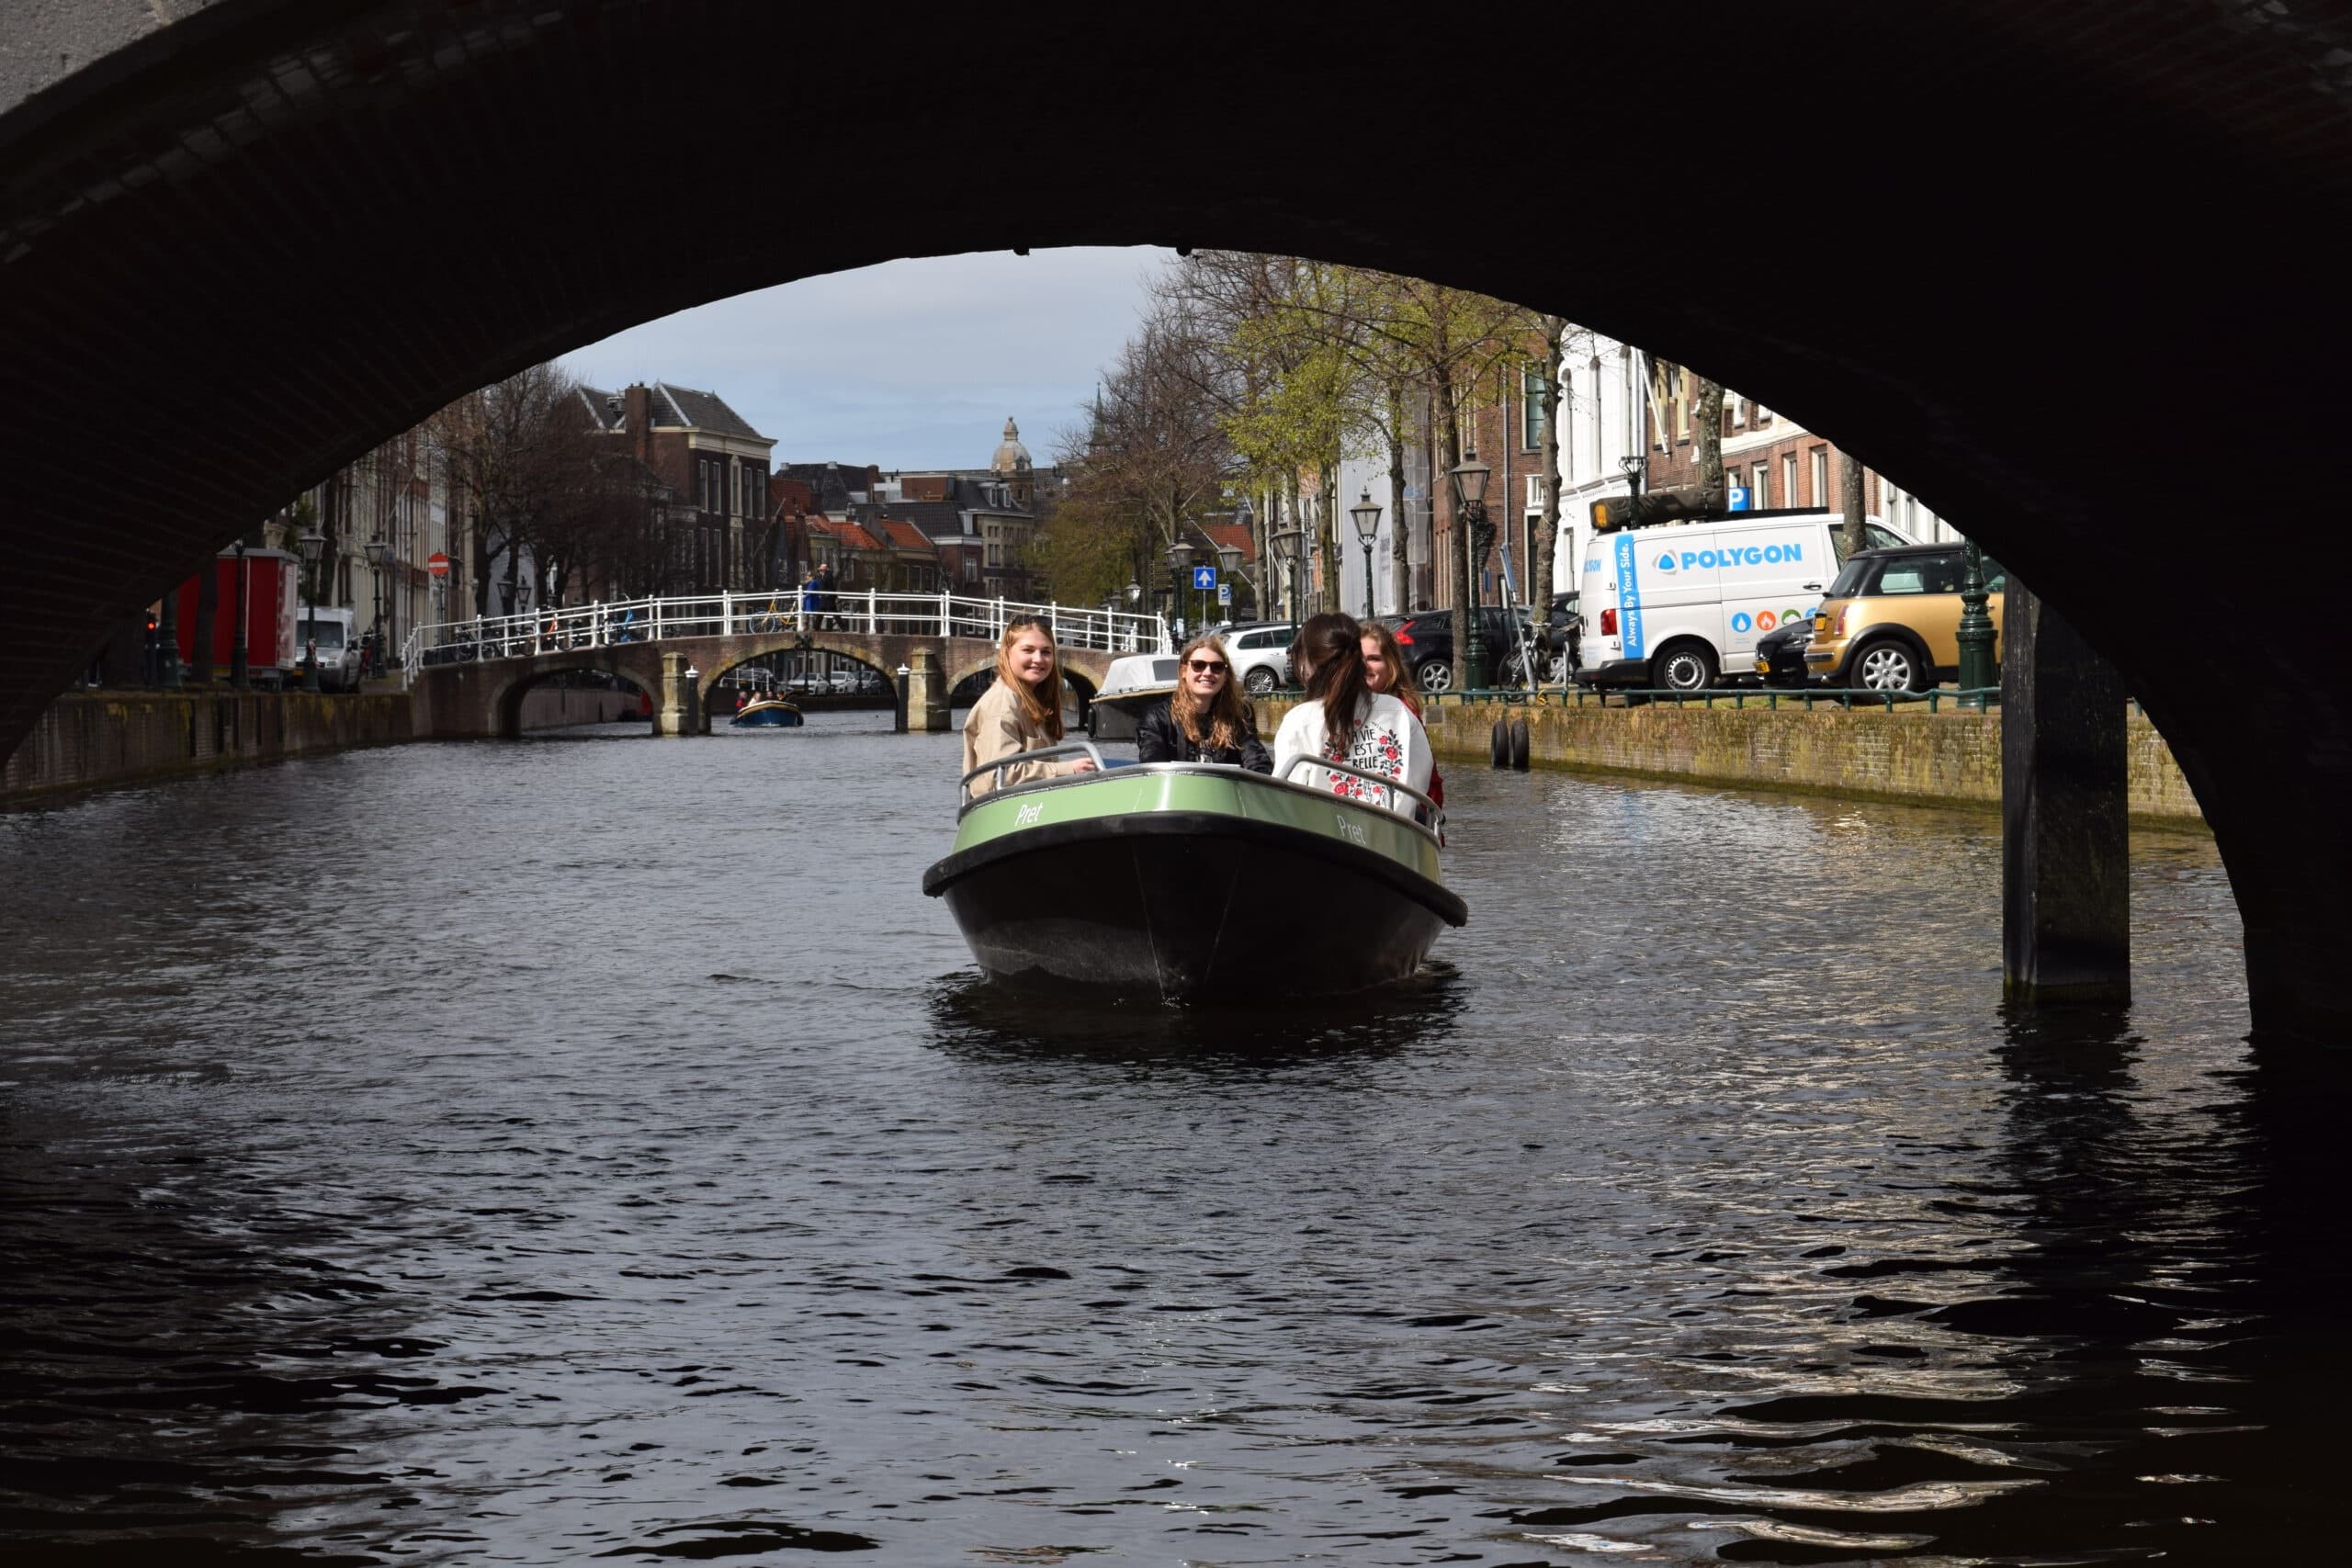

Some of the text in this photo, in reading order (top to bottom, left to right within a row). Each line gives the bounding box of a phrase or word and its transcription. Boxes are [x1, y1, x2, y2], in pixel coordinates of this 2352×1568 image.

[1728, 488, 1744, 513] P
[1681, 544, 1803, 570] POLYGON
[1220, 587, 1229, 601] P
[1620, 543, 1638, 647] Always By Your Side.
[1360, 726, 1377, 741] VIE
[1354, 742, 1373, 756] EST
[1014, 802, 1044, 827] Pret
[1337, 815, 1366, 846] Pret
